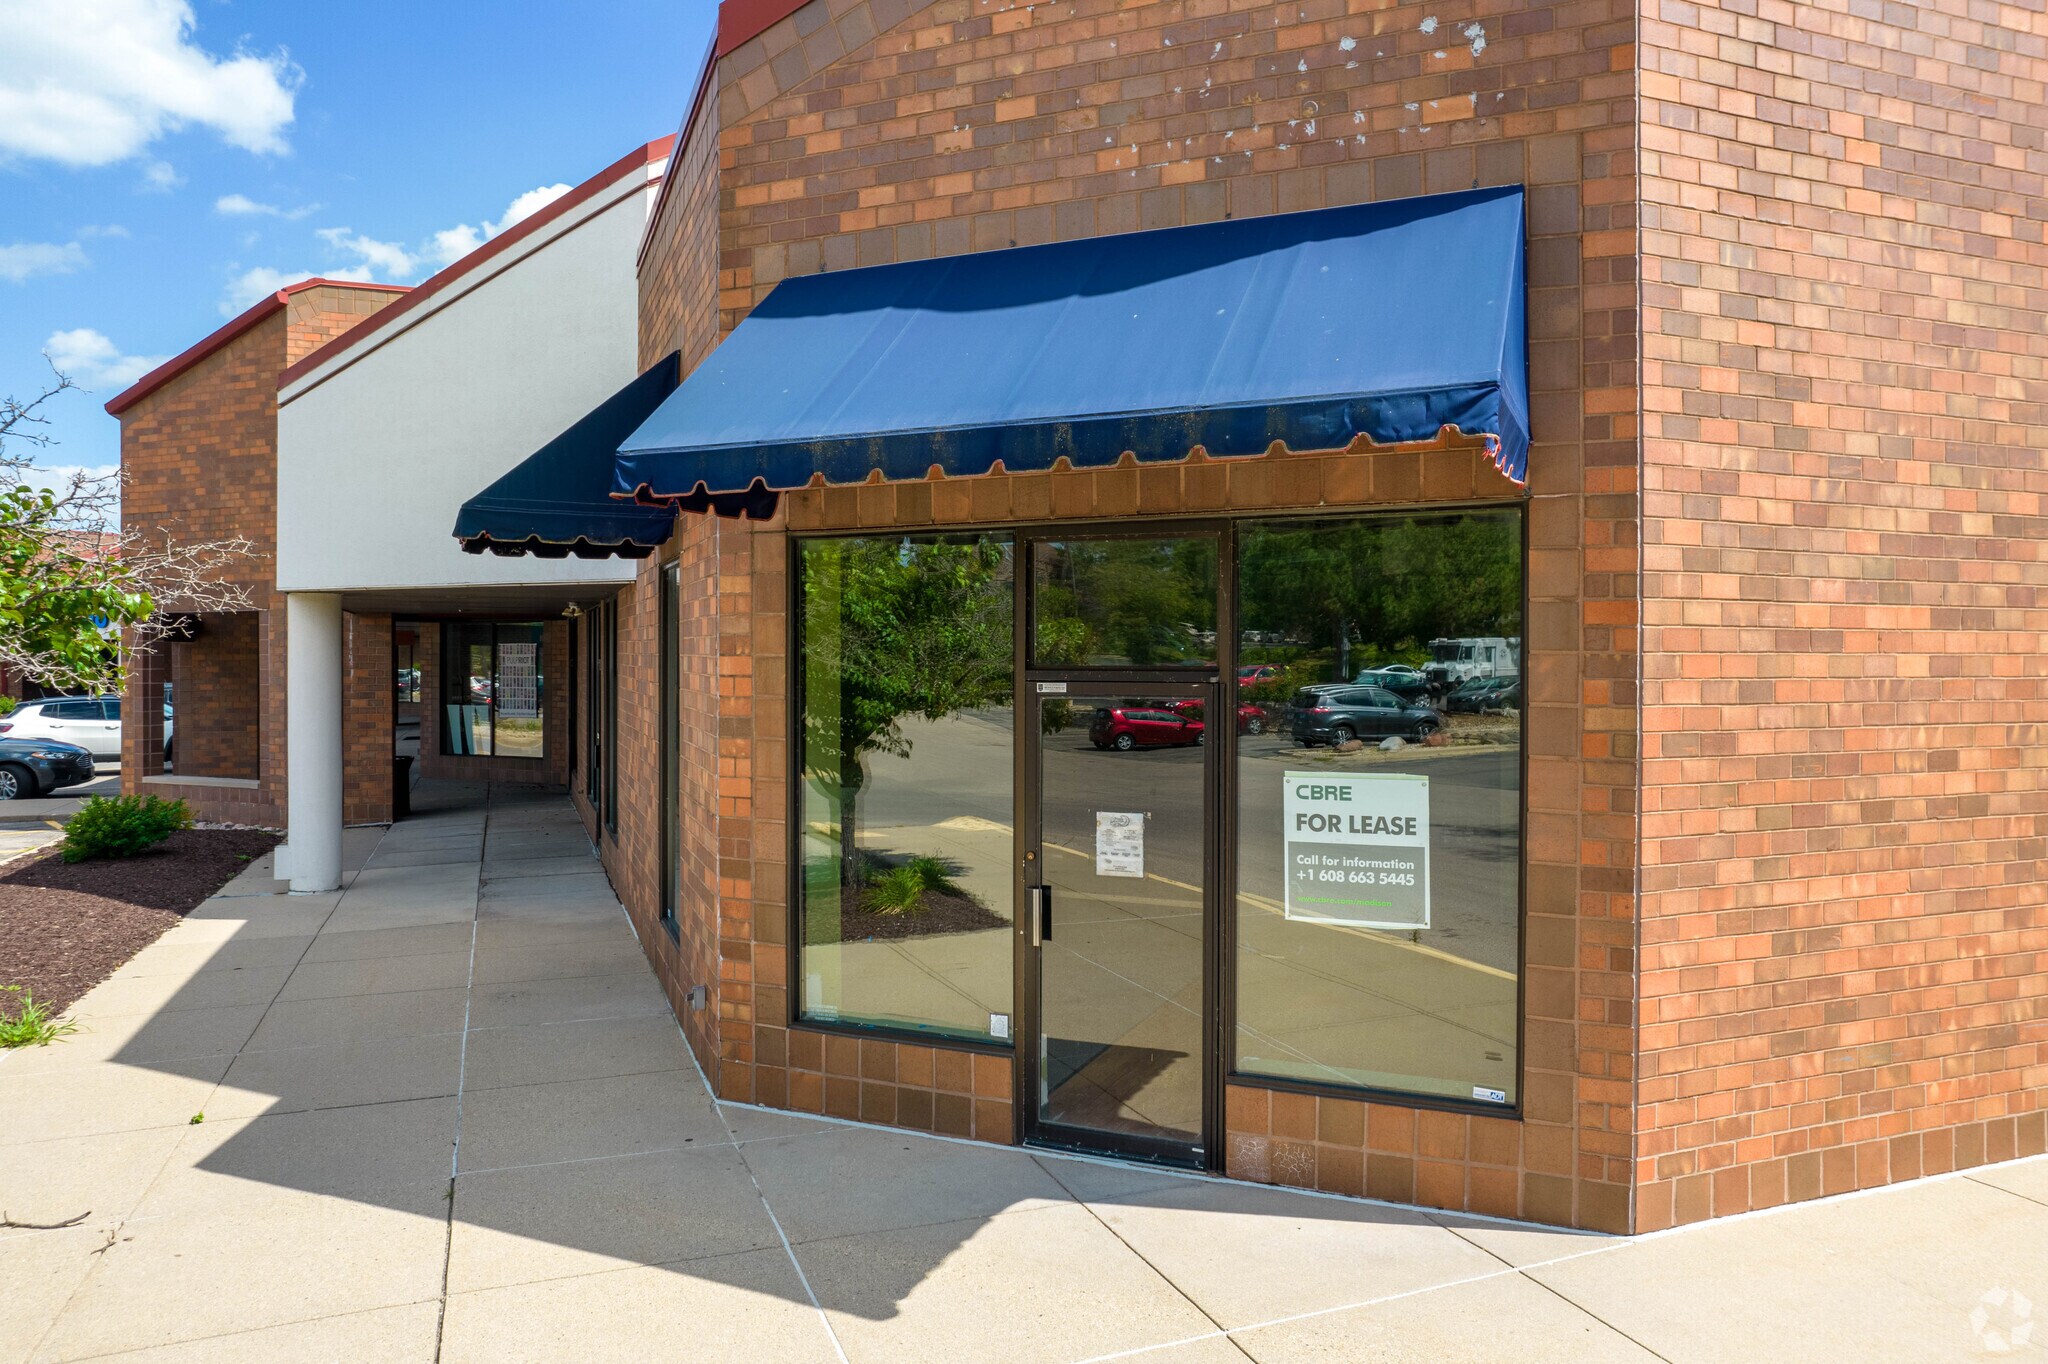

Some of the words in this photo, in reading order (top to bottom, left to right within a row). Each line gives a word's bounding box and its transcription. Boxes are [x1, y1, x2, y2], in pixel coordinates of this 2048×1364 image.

[1296, 785, 1352, 801] CBRE
[1296, 813, 1342, 833] FOR
[1349, 815, 1417, 836] LEASE
[1296, 855, 1319, 865] Call
[1322, 856, 1339, 866] for
[1342, 857, 1415, 870] information
[1297, 869, 1313, 881] +1
[1319, 870, 1345, 883] 608
[1348, 871, 1375, 884] 663
[1379, 872, 1415, 886] 5445
